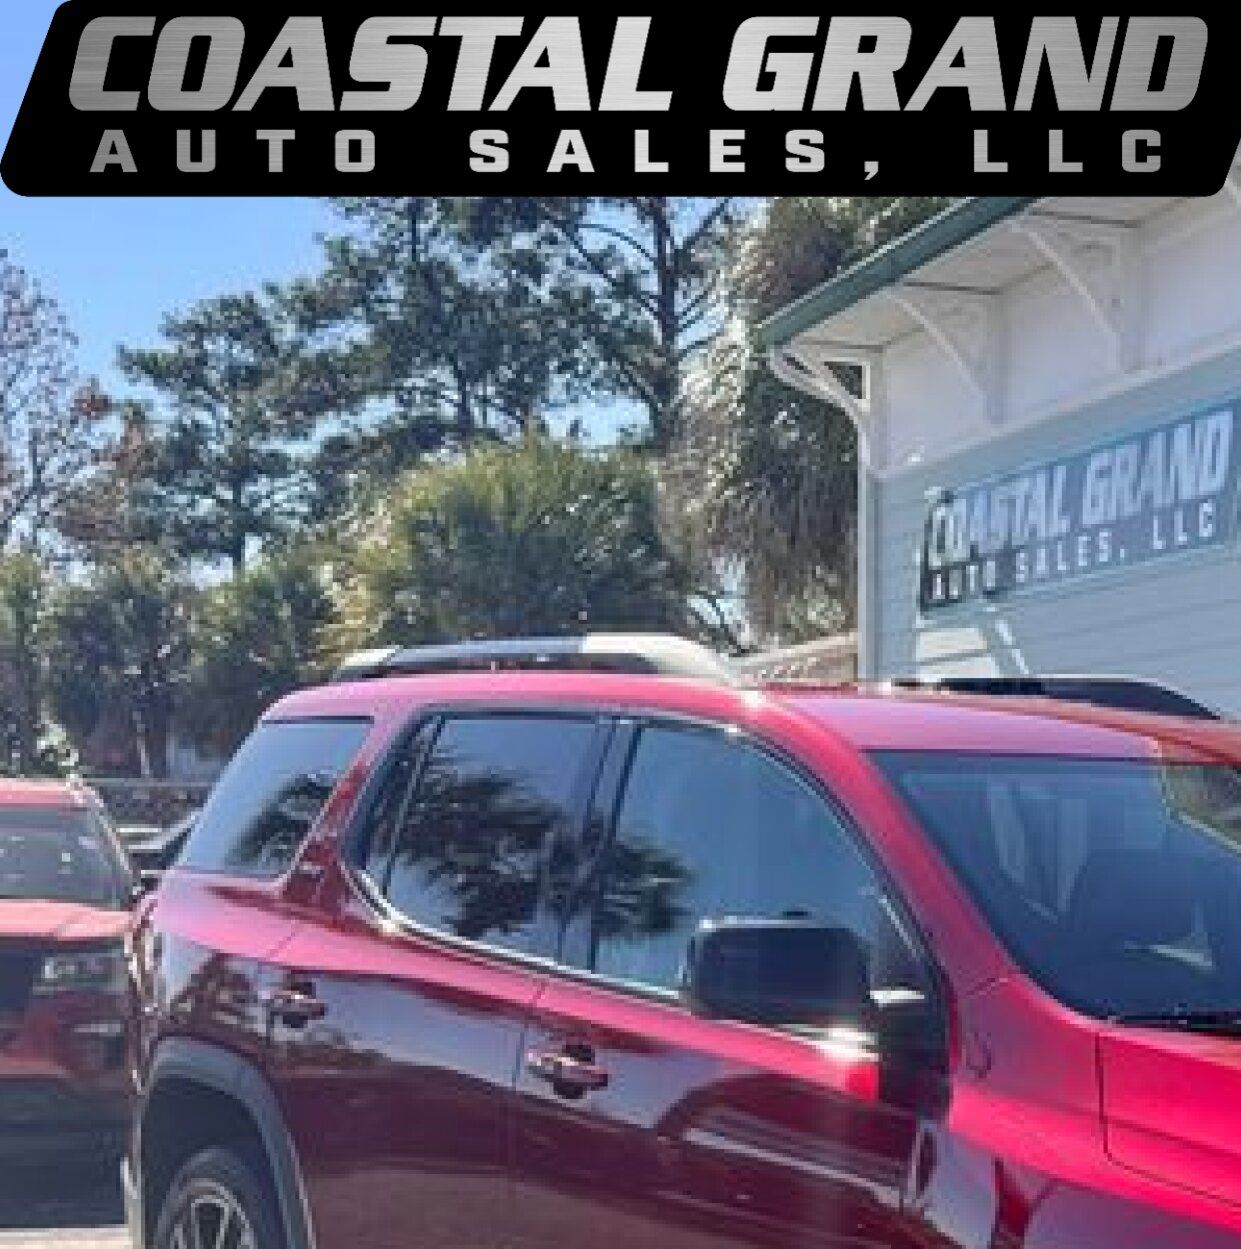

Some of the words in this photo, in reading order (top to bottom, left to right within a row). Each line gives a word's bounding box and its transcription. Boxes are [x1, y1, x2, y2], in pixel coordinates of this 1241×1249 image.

[927, 464, 1071, 568] COASTAL
[1081, 409, 1234, 526] GRAND
[1151, 500, 1214, 551] LLC
